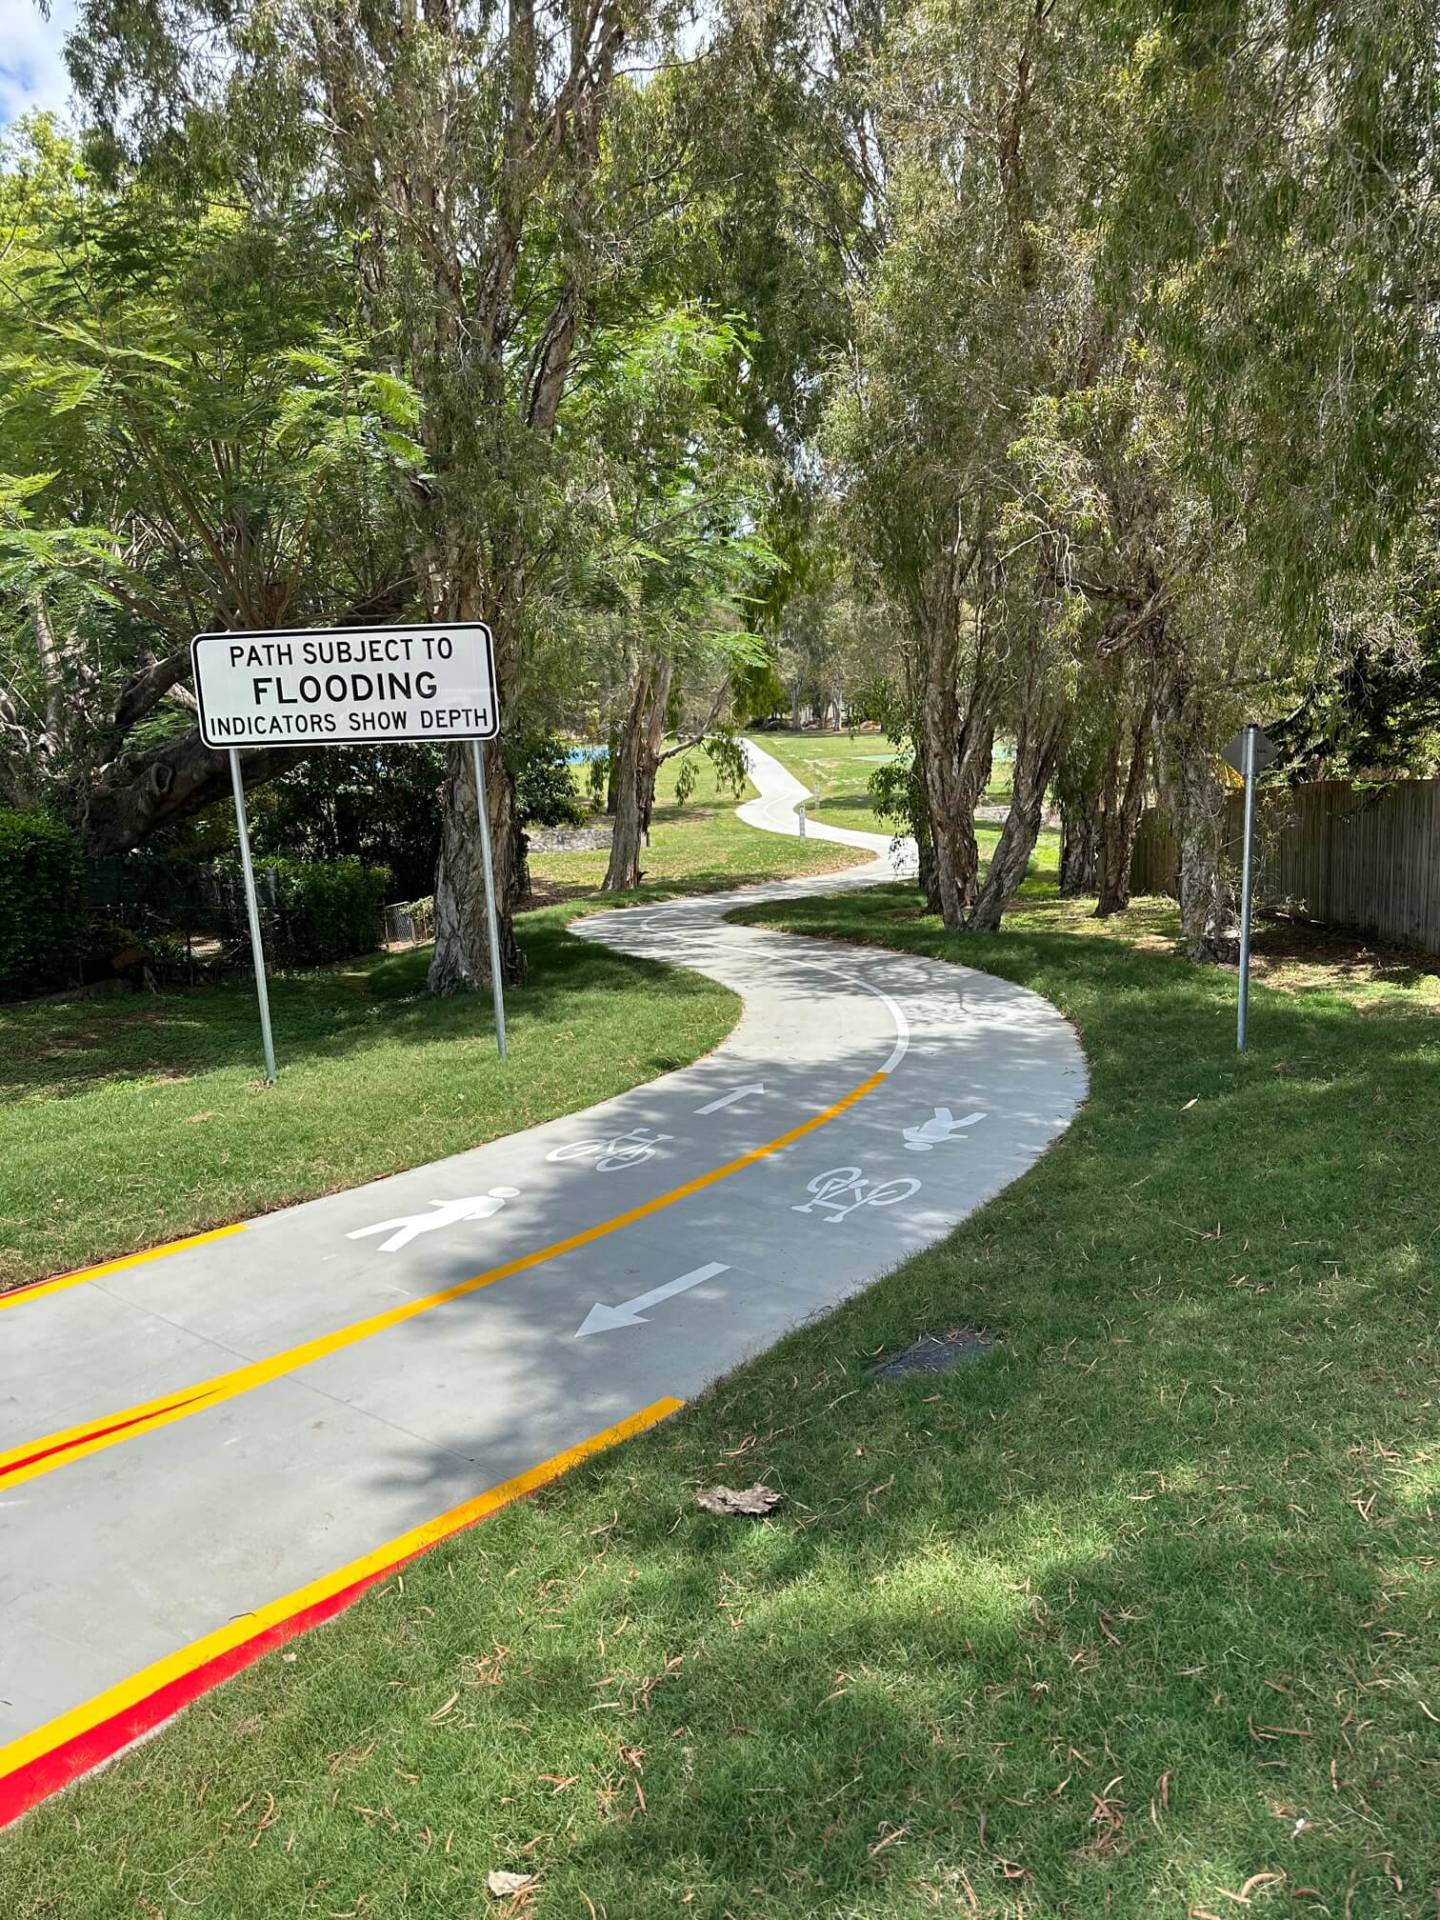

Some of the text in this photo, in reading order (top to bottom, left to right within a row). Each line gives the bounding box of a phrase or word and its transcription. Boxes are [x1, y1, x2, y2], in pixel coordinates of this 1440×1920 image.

[229, 637, 453, 667] PATH SUBJECT TO
[253, 671, 438, 705] FLOODING
[210, 708, 488, 736] INDICATORS SHOW DEPTH
